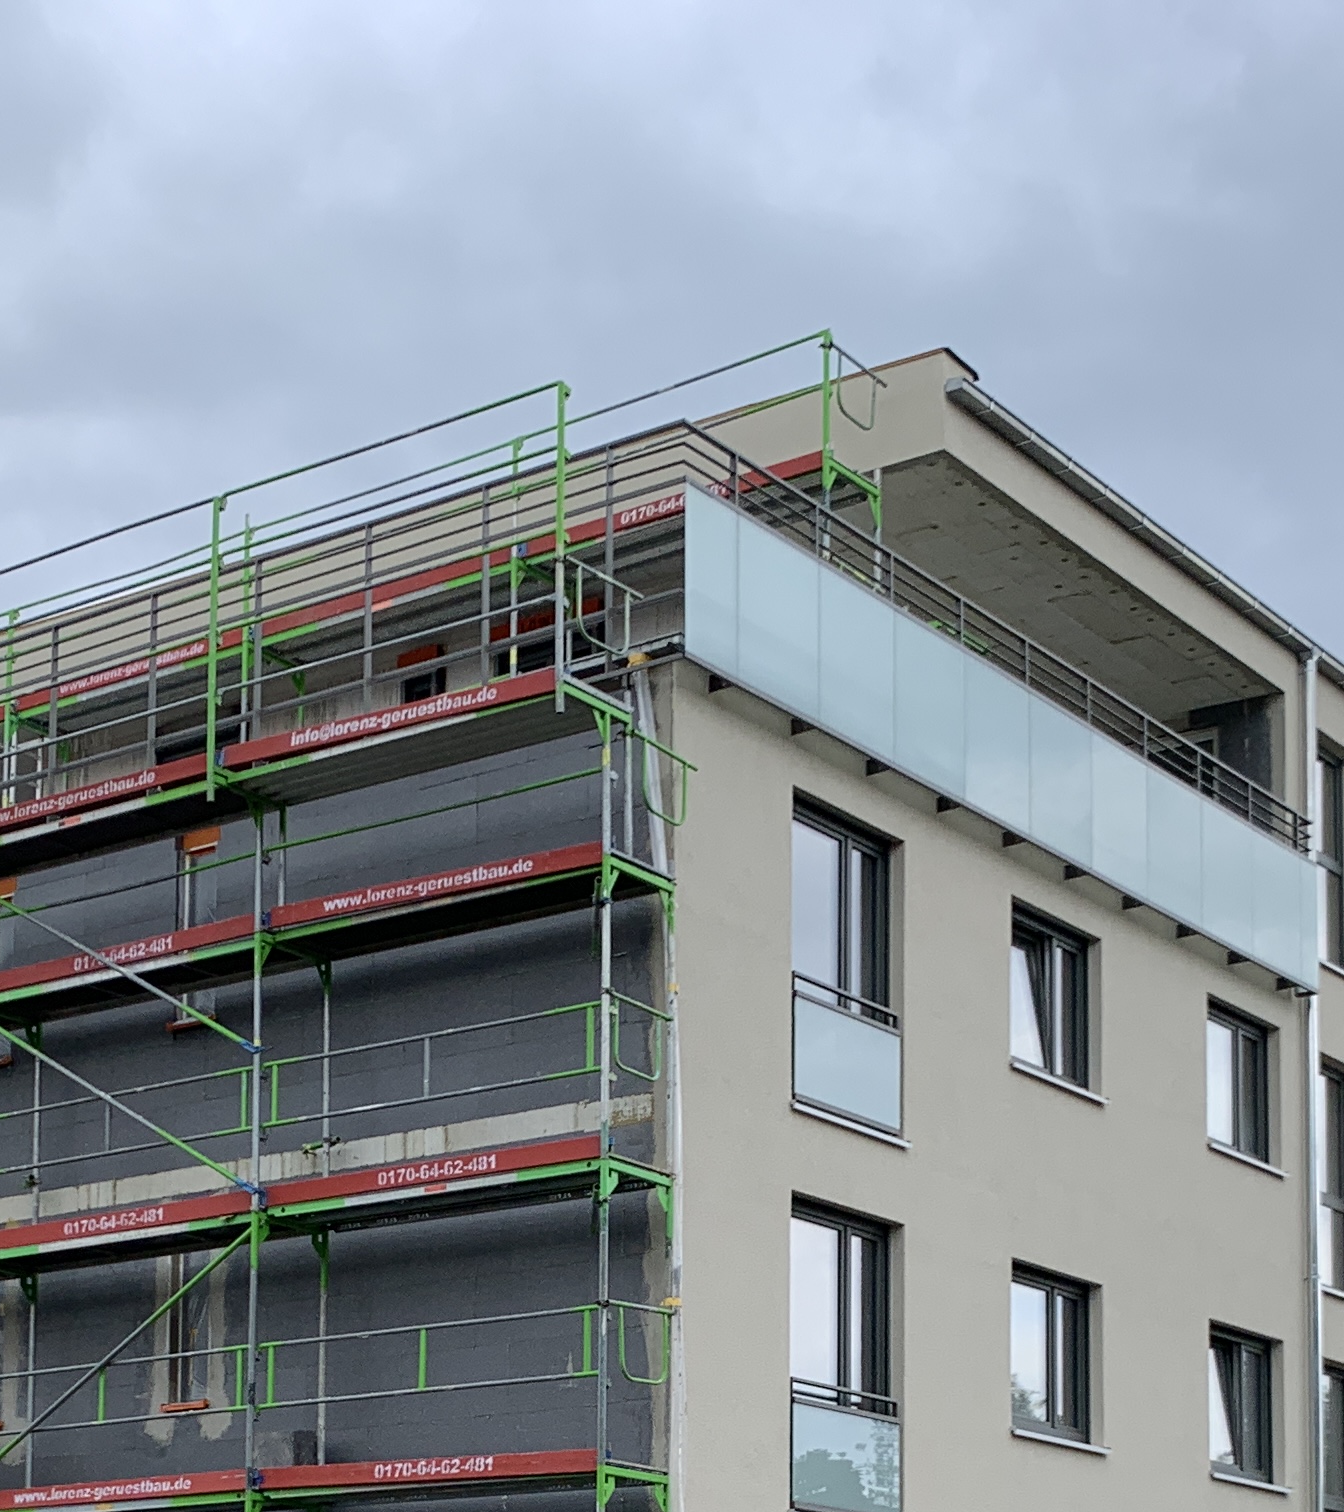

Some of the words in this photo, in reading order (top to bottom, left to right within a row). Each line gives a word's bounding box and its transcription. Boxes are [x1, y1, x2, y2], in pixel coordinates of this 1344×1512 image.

[59, 642, 205, 694] www.lorenz-gerustbau.de
[290, 686, 497, 747] info@lorenz-geruestbau.de
[323, 857, 534, 914] www.lorenz-geruestbau.de
[378, 1155, 497, 1186] 0170-64-62-481
[63, 1207, 164, 1236] 0170-64-62-481
[374, 1456, 494, 1481] 0170-64-62-481
[13, 1475, 192, 1505] www.lorenz-geruestbau.de
